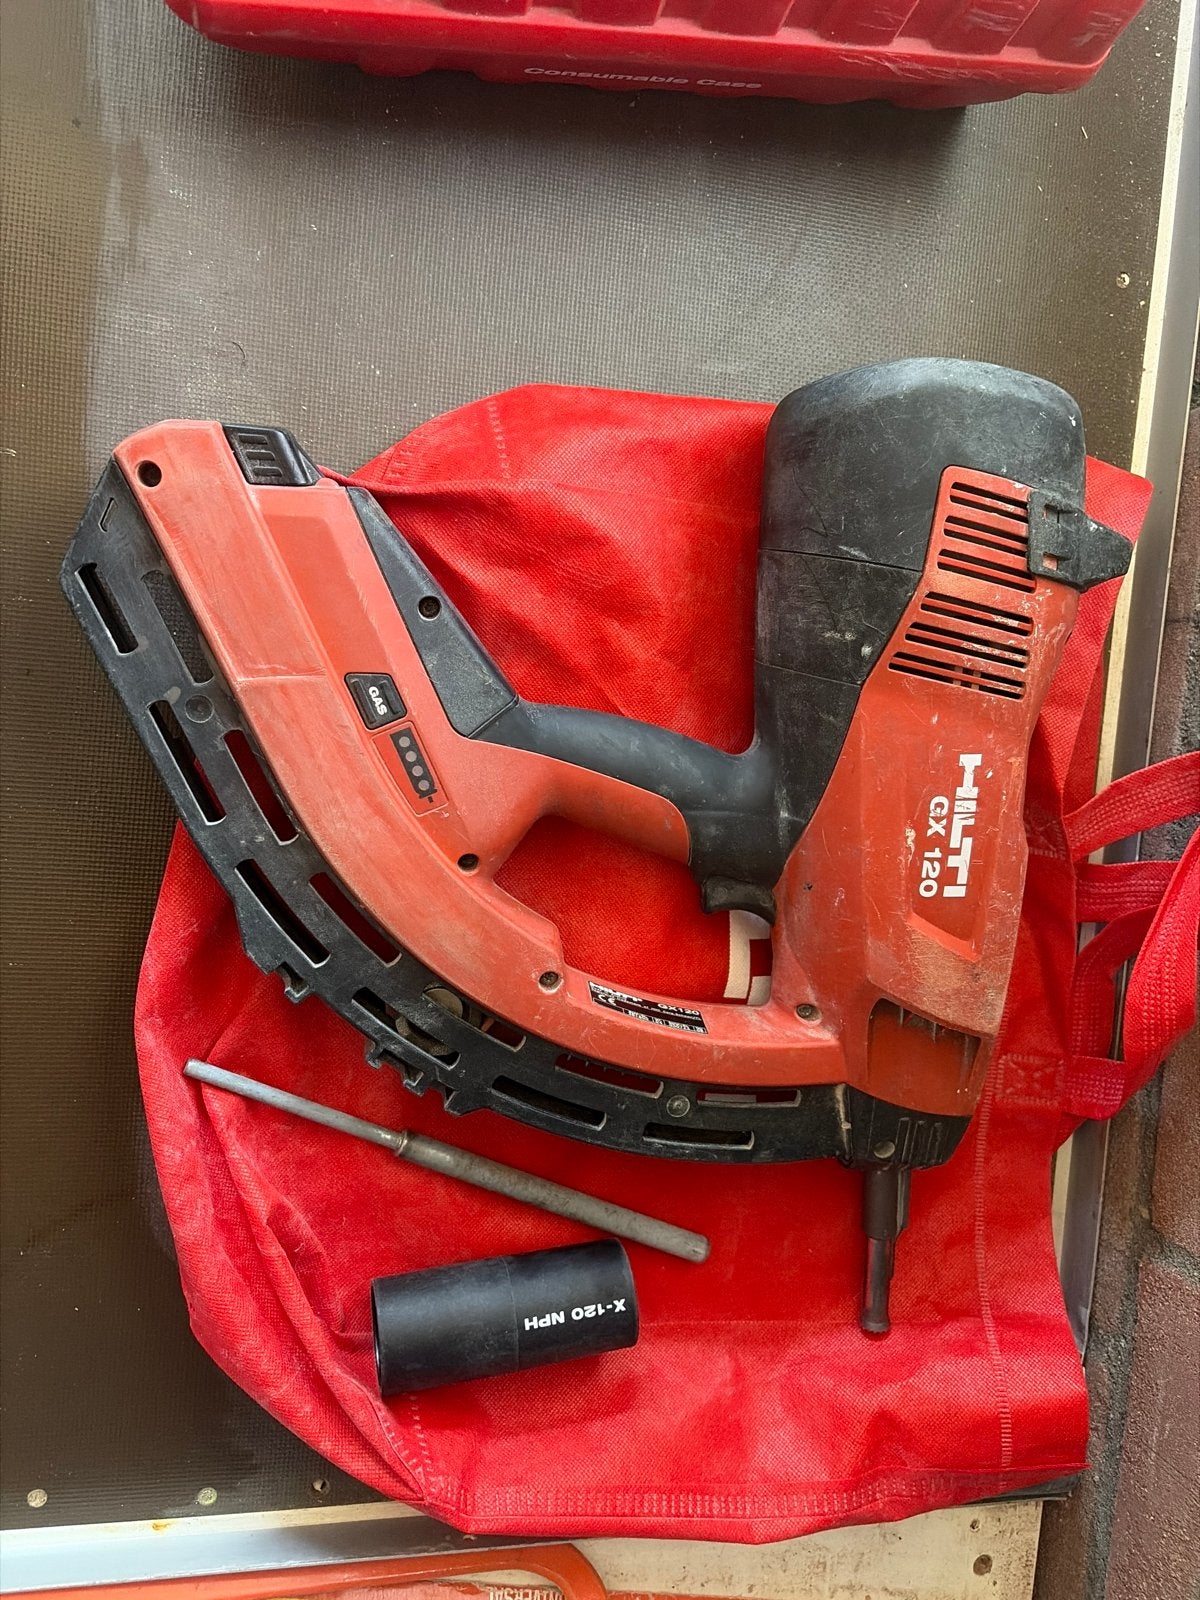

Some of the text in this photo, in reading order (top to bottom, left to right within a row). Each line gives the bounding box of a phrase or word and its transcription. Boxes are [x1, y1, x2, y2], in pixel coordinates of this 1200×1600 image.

[524, 67, 762, 89] Consumable Case
[369, 686, 388, 715] GAS
[942, 753, 982, 898] HILTI
[919, 796, 949, 898] GX 120
[524, 1298, 626, 1331] X-120 NPH
